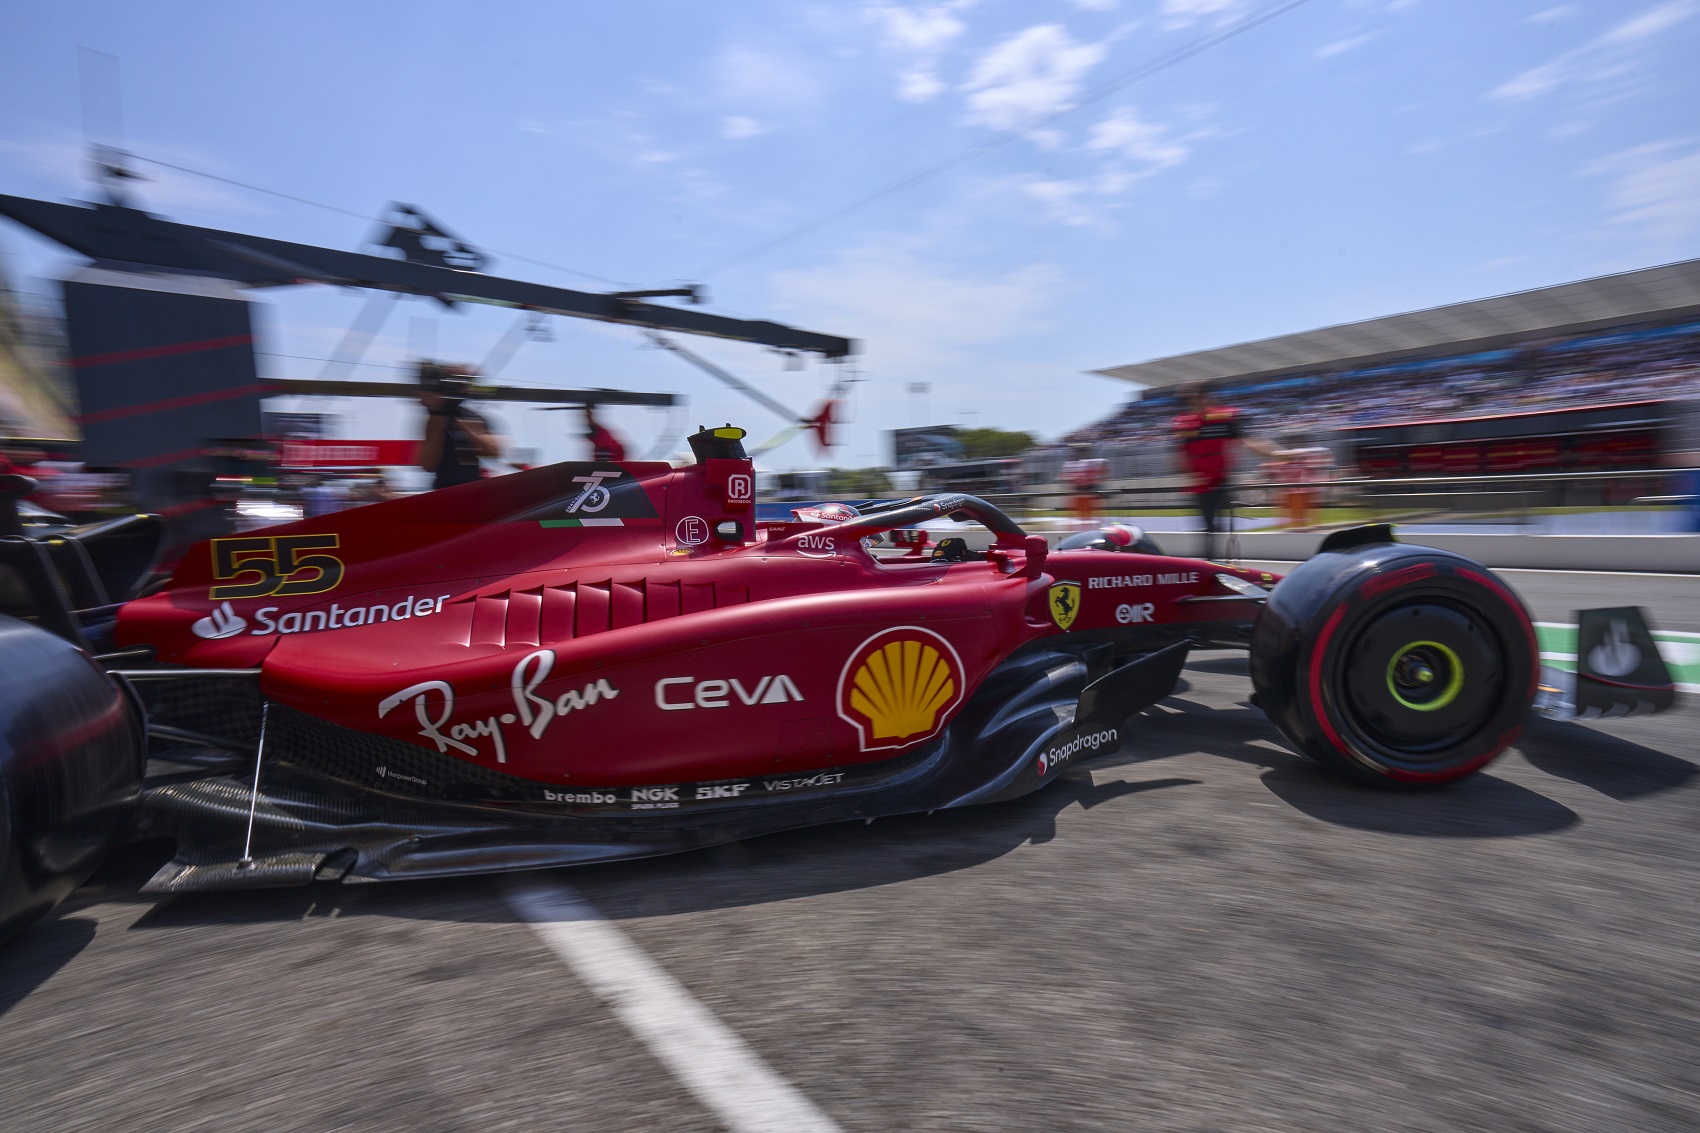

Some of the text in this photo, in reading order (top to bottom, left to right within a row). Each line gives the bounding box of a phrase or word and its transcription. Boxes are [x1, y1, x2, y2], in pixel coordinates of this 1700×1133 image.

[797, 535, 835, 550] aws
[208, 533, 345, 601] 55
[1088, 571, 1200, 589] RICHARD MILLE
[251, 594, 451, 636] Santander
[378, 649, 620, 764] Ray-Ban
[1049, 728, 1118, 767] Snapdragon
[543, 789, 617, 804] brembo
[630, 787, 680, 802] NGK
[695, 783, 751, 800] SKF
